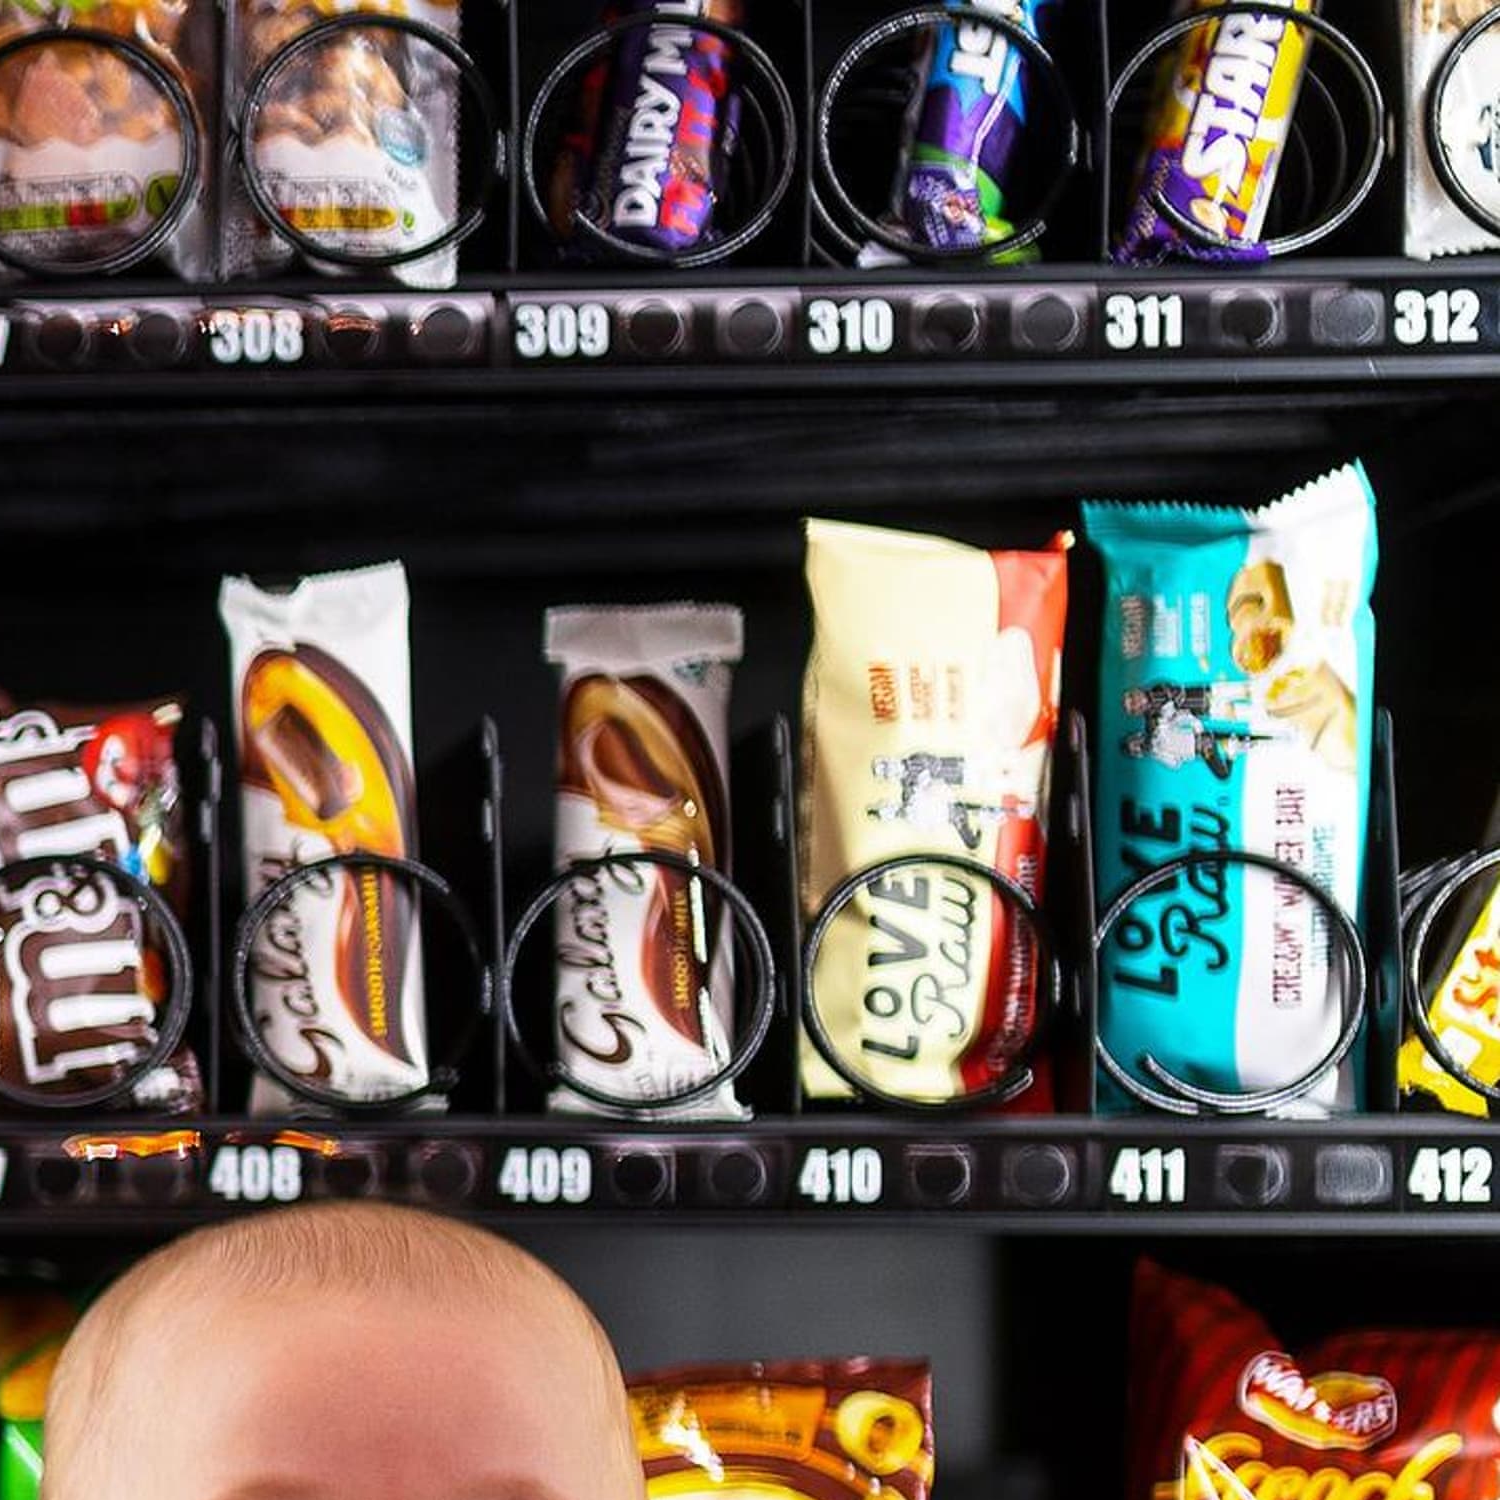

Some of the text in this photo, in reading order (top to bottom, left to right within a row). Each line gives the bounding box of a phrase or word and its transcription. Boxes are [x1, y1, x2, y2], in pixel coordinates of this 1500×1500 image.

[612, 0, 707, 229] DAIRY MIL
[1180, 0, 1293, 203] STAR
[210, 308, 303, 363] 308
[515, 304, 609, 358] 309
[808, 299, 893, 353] 310
[1105, 295, 1184, 348] 311
[1394, 289, 1480, 344] 312
[1113, 800, 1182, 997] LOVE
[1158, 805, 1232, 972] Raw
[860, 872, 930, 1061] LOVE
[910, 877, 977, 1039] Raw
[211, 1146, 302, 1202] 408
[501, 1147, 593, 1202] 409
[799, 1147, 882, 1202] 410
[1110, 1147, 1187, 1203] 411
[1408, 1146, 1493, 1202] 412
